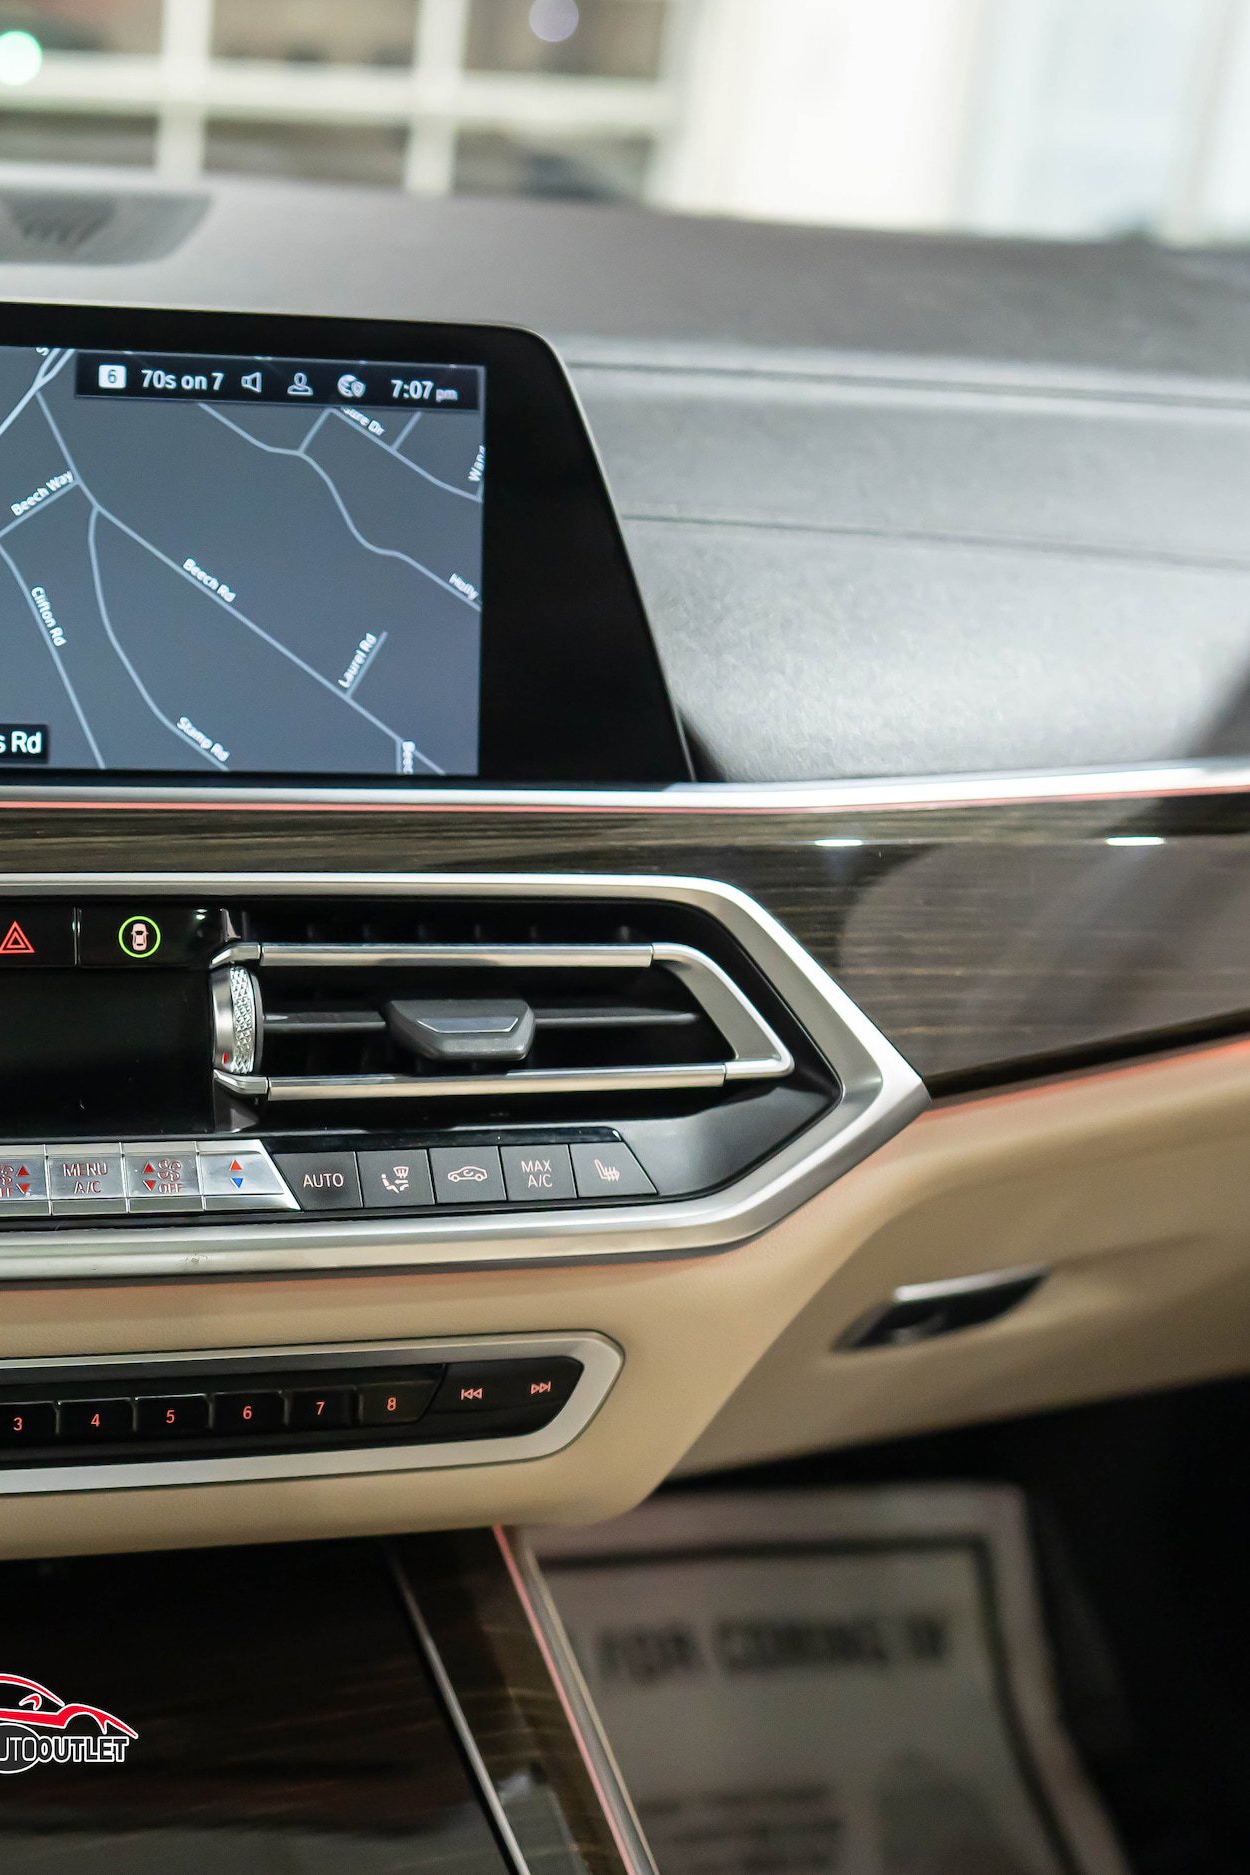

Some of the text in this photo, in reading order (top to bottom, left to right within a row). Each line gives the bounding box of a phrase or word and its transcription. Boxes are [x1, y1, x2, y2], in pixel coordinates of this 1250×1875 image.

[107, 369, 117, 384] 6
[141, 369, 225, 391] 70s on 7
[391, 380, 459, 402] 7:07 pm
[368, 419, 385, 436] Dr
[10, 470, 74, 516] Beech Way
[182, 558, 237, 603] Beech Rd
[31, 586, 67, 647] Clifton Rd
[358, 632, 377, 653] Rd
[11, 731, 42, 754] Rd
[210, 742, 230, 762] Rd
[62, 1162, 108, 1177] MENU
[521, 1159, 552, 1173] MAX
[73, 1180, 102, 1195] A/C
[158, 1182, 184, 1195] OFF
[303, 1172, 344, 1189] AUTO
[527, 1173, 553, 1188] A/C
[315, 1401, 326, 1416] 7
[386, 1396, 398, 1412] 8
[90, 1413, 101, 1428] 4
[165, 1409, 176, 1425] 5
[242, 1405, 253, 1421] 6
[13, 1416, 24, 1432] 3
